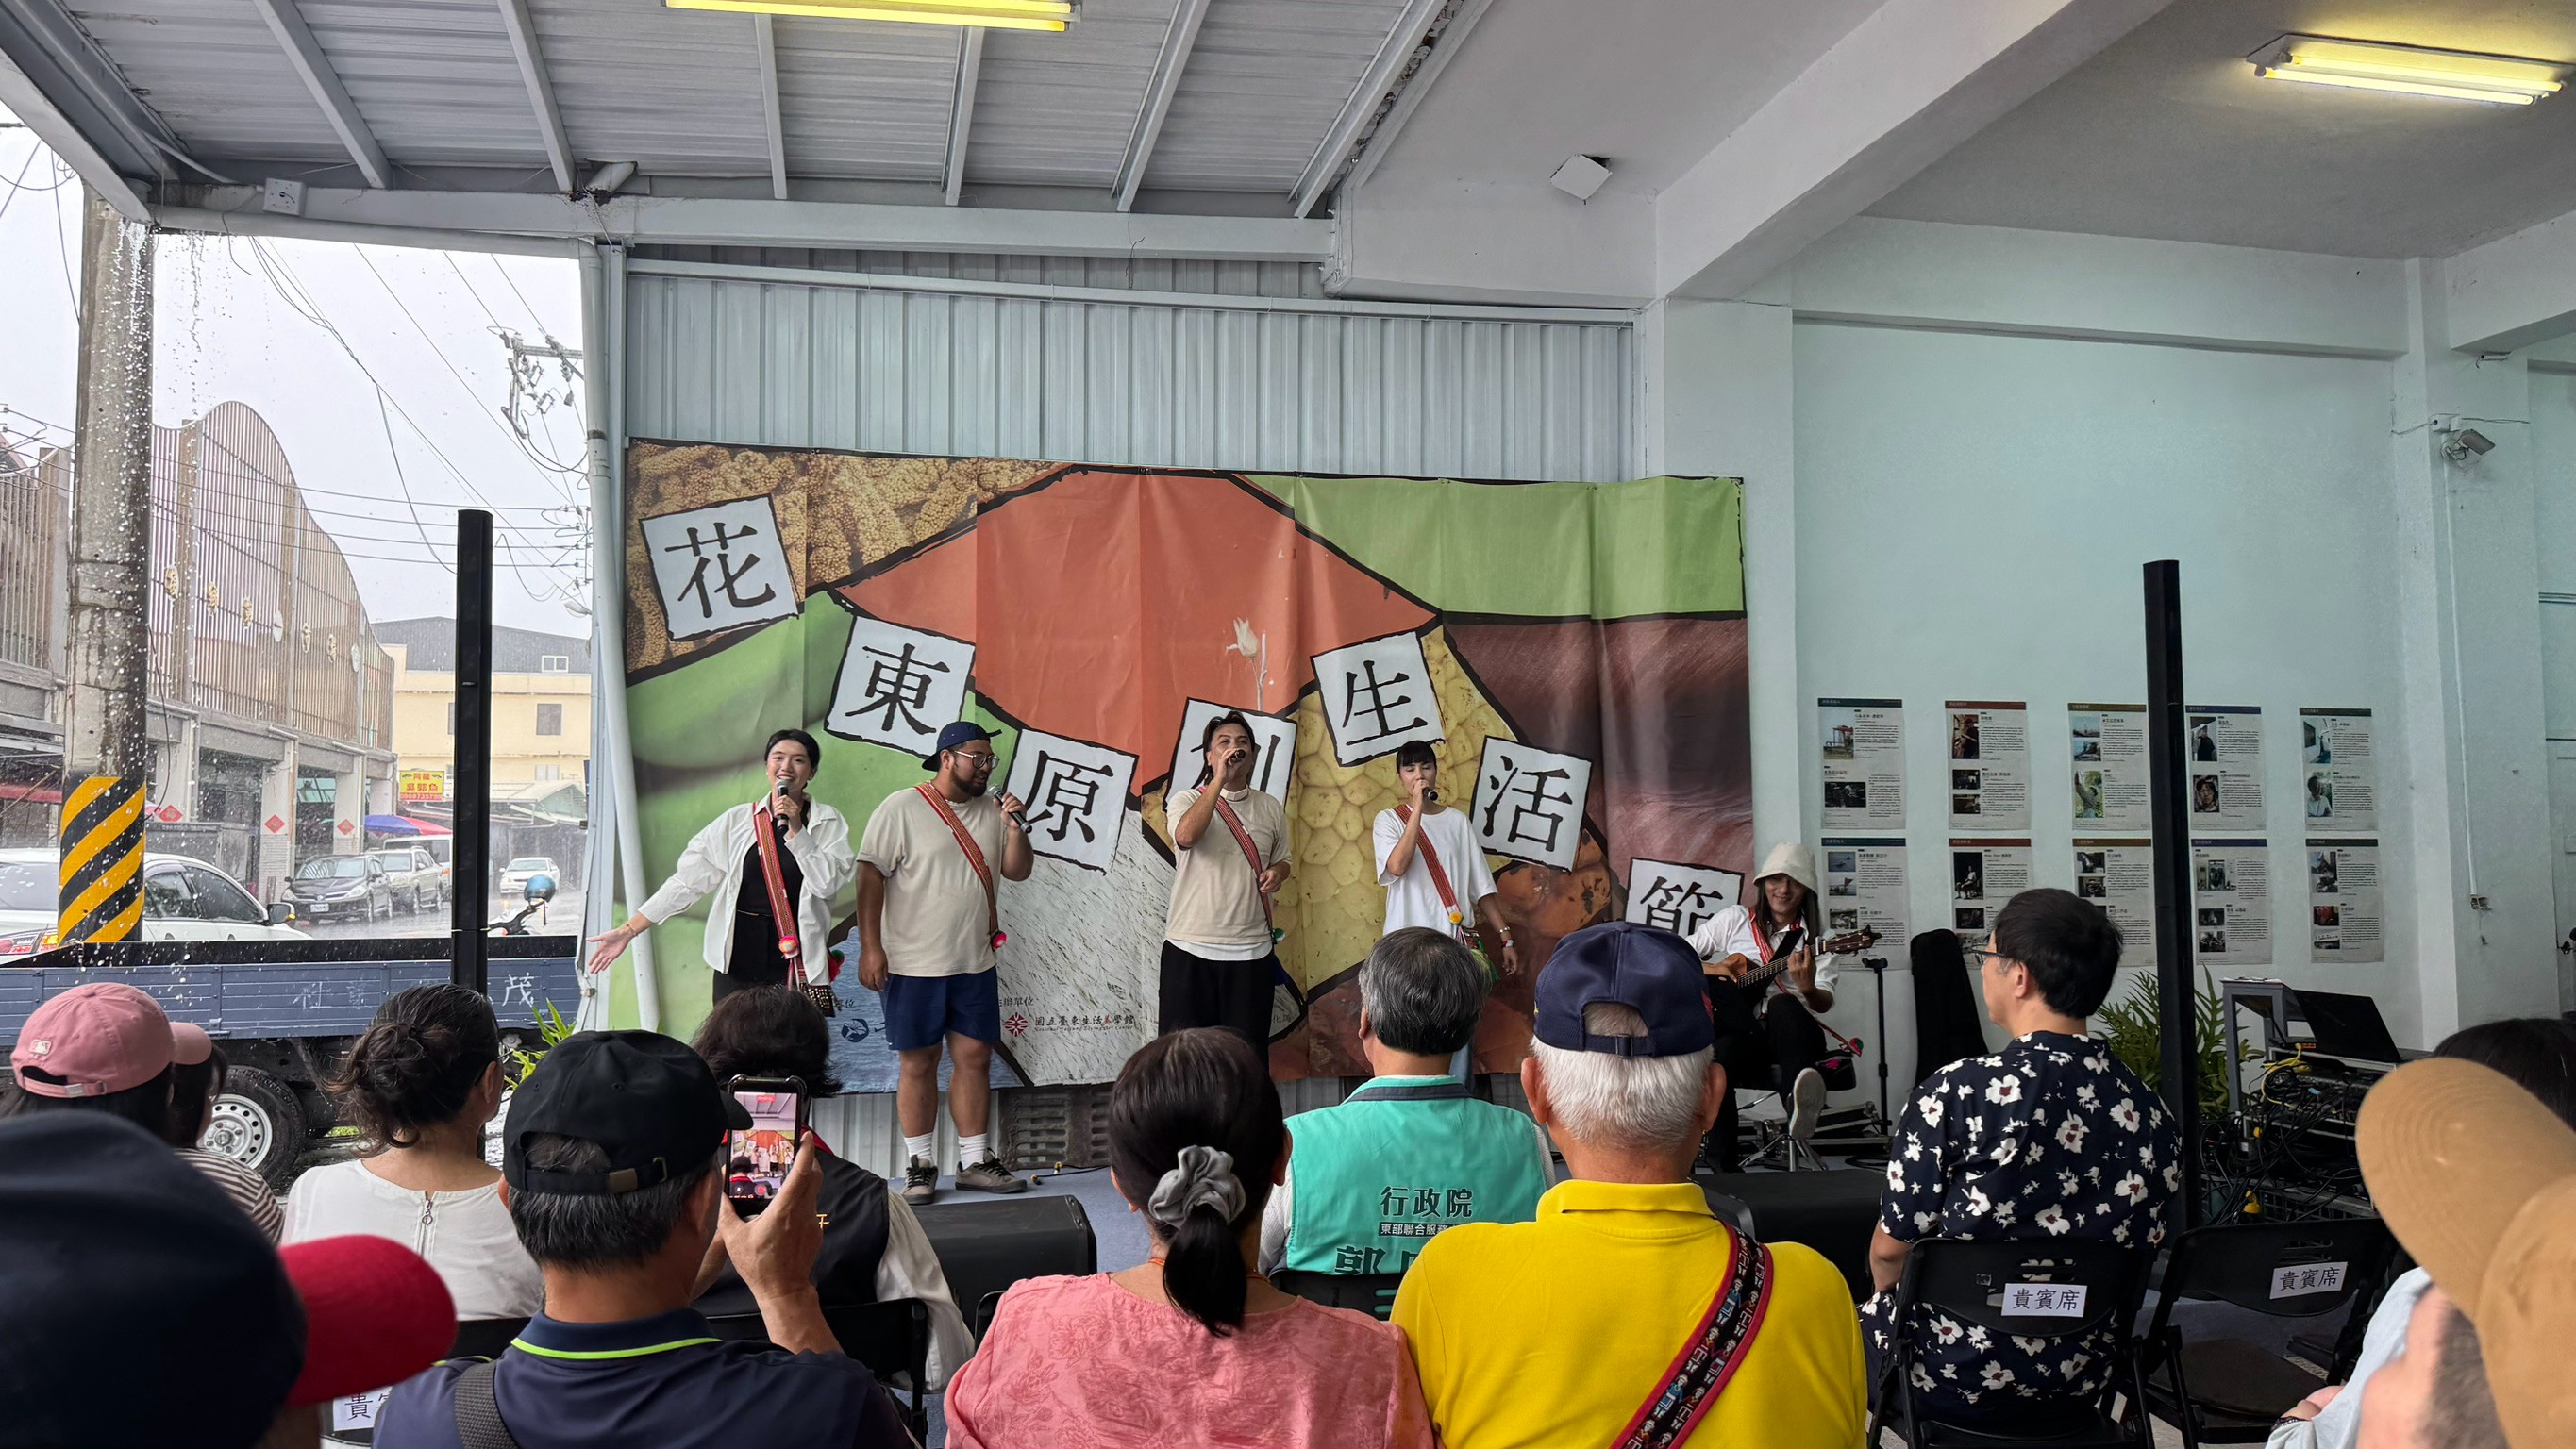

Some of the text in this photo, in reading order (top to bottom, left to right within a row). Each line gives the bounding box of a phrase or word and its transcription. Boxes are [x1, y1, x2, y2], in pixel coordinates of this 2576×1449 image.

[665, 522, 777, 618] 花
[845, 642, 950, 736] 東
[1024, 749, 1114, 843] 原
[1342, 660, 1429, 746] 生
[1482, 755, 1574, 852] 活
[1380, 1186, 1473, 1218] 行政院
[2278, 1266, 2340, 1291] 貴賓席
[2012, 1288, 2081, 1312] 貴賓席
[344, 1393, 389, 1421] 貴
